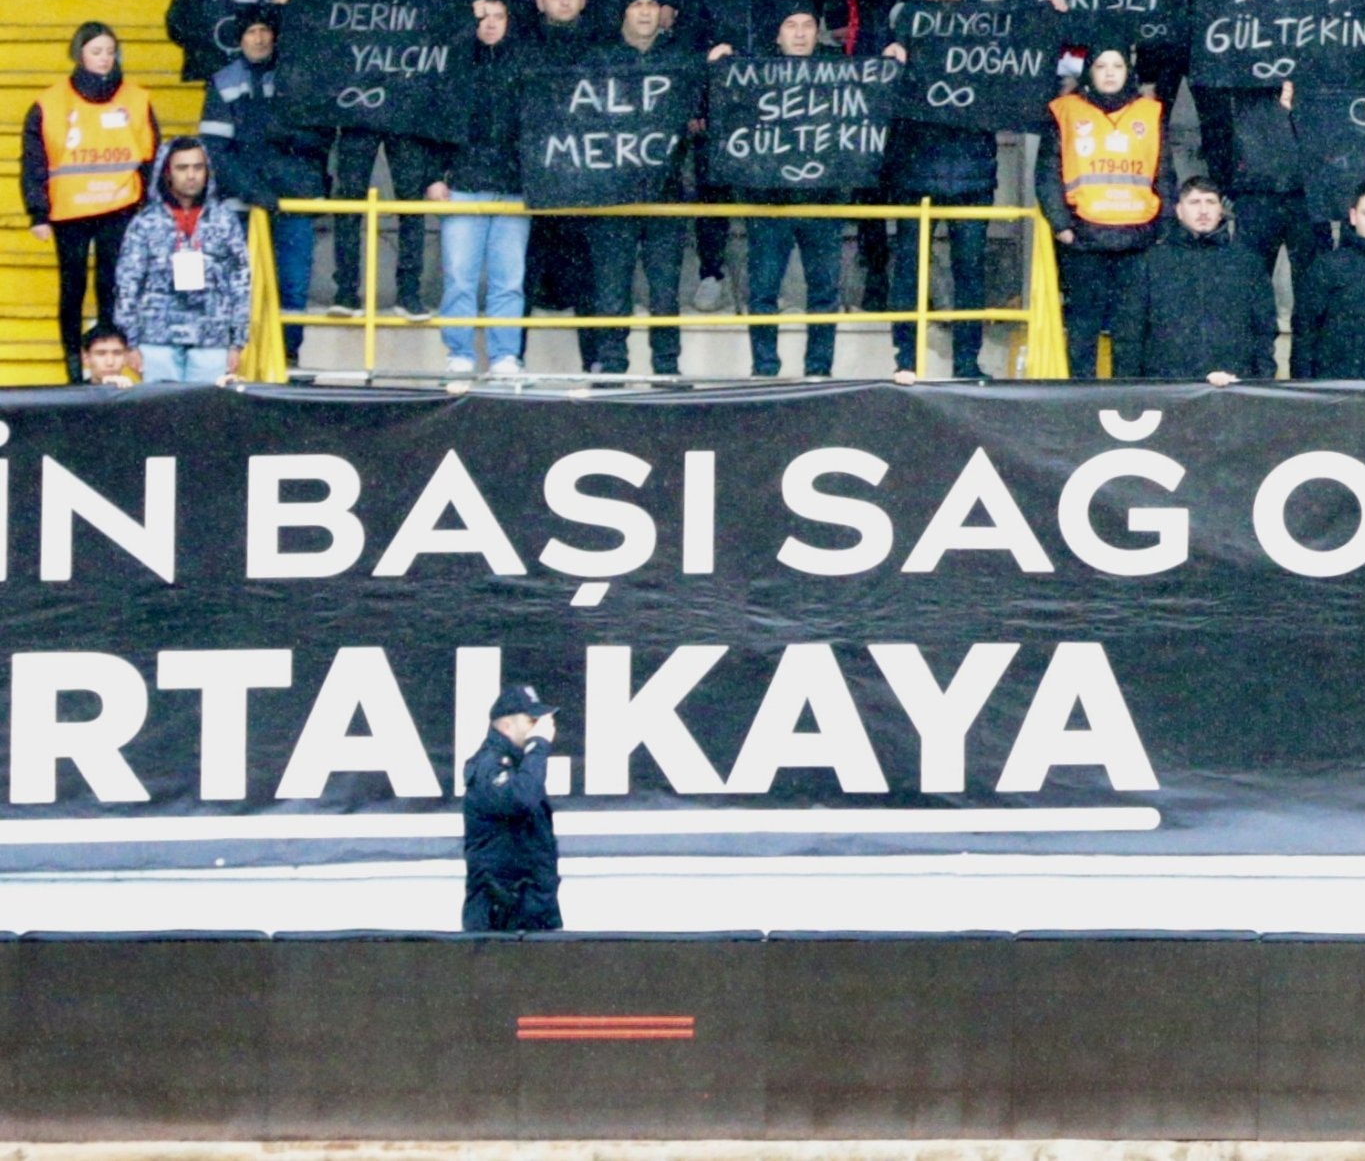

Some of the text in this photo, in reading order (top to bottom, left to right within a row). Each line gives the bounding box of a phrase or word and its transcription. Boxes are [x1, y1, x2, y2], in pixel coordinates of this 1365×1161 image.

[910, 10, 1013, 39] DUYGU
[725, 58, 901, 88] MUHAMMED
[944, 39, 1045, 77] DOĞAN
[569, 75, 672, 115] ALP
[725, 118, 889, 161] GÜLTEKİN
[1089, 159, 1143, 174] 179-012
[0, 420, 176, 584] N
[246, 448, 716, 607] BAŞI
[776, 408, 1191, 577] SAĞ
